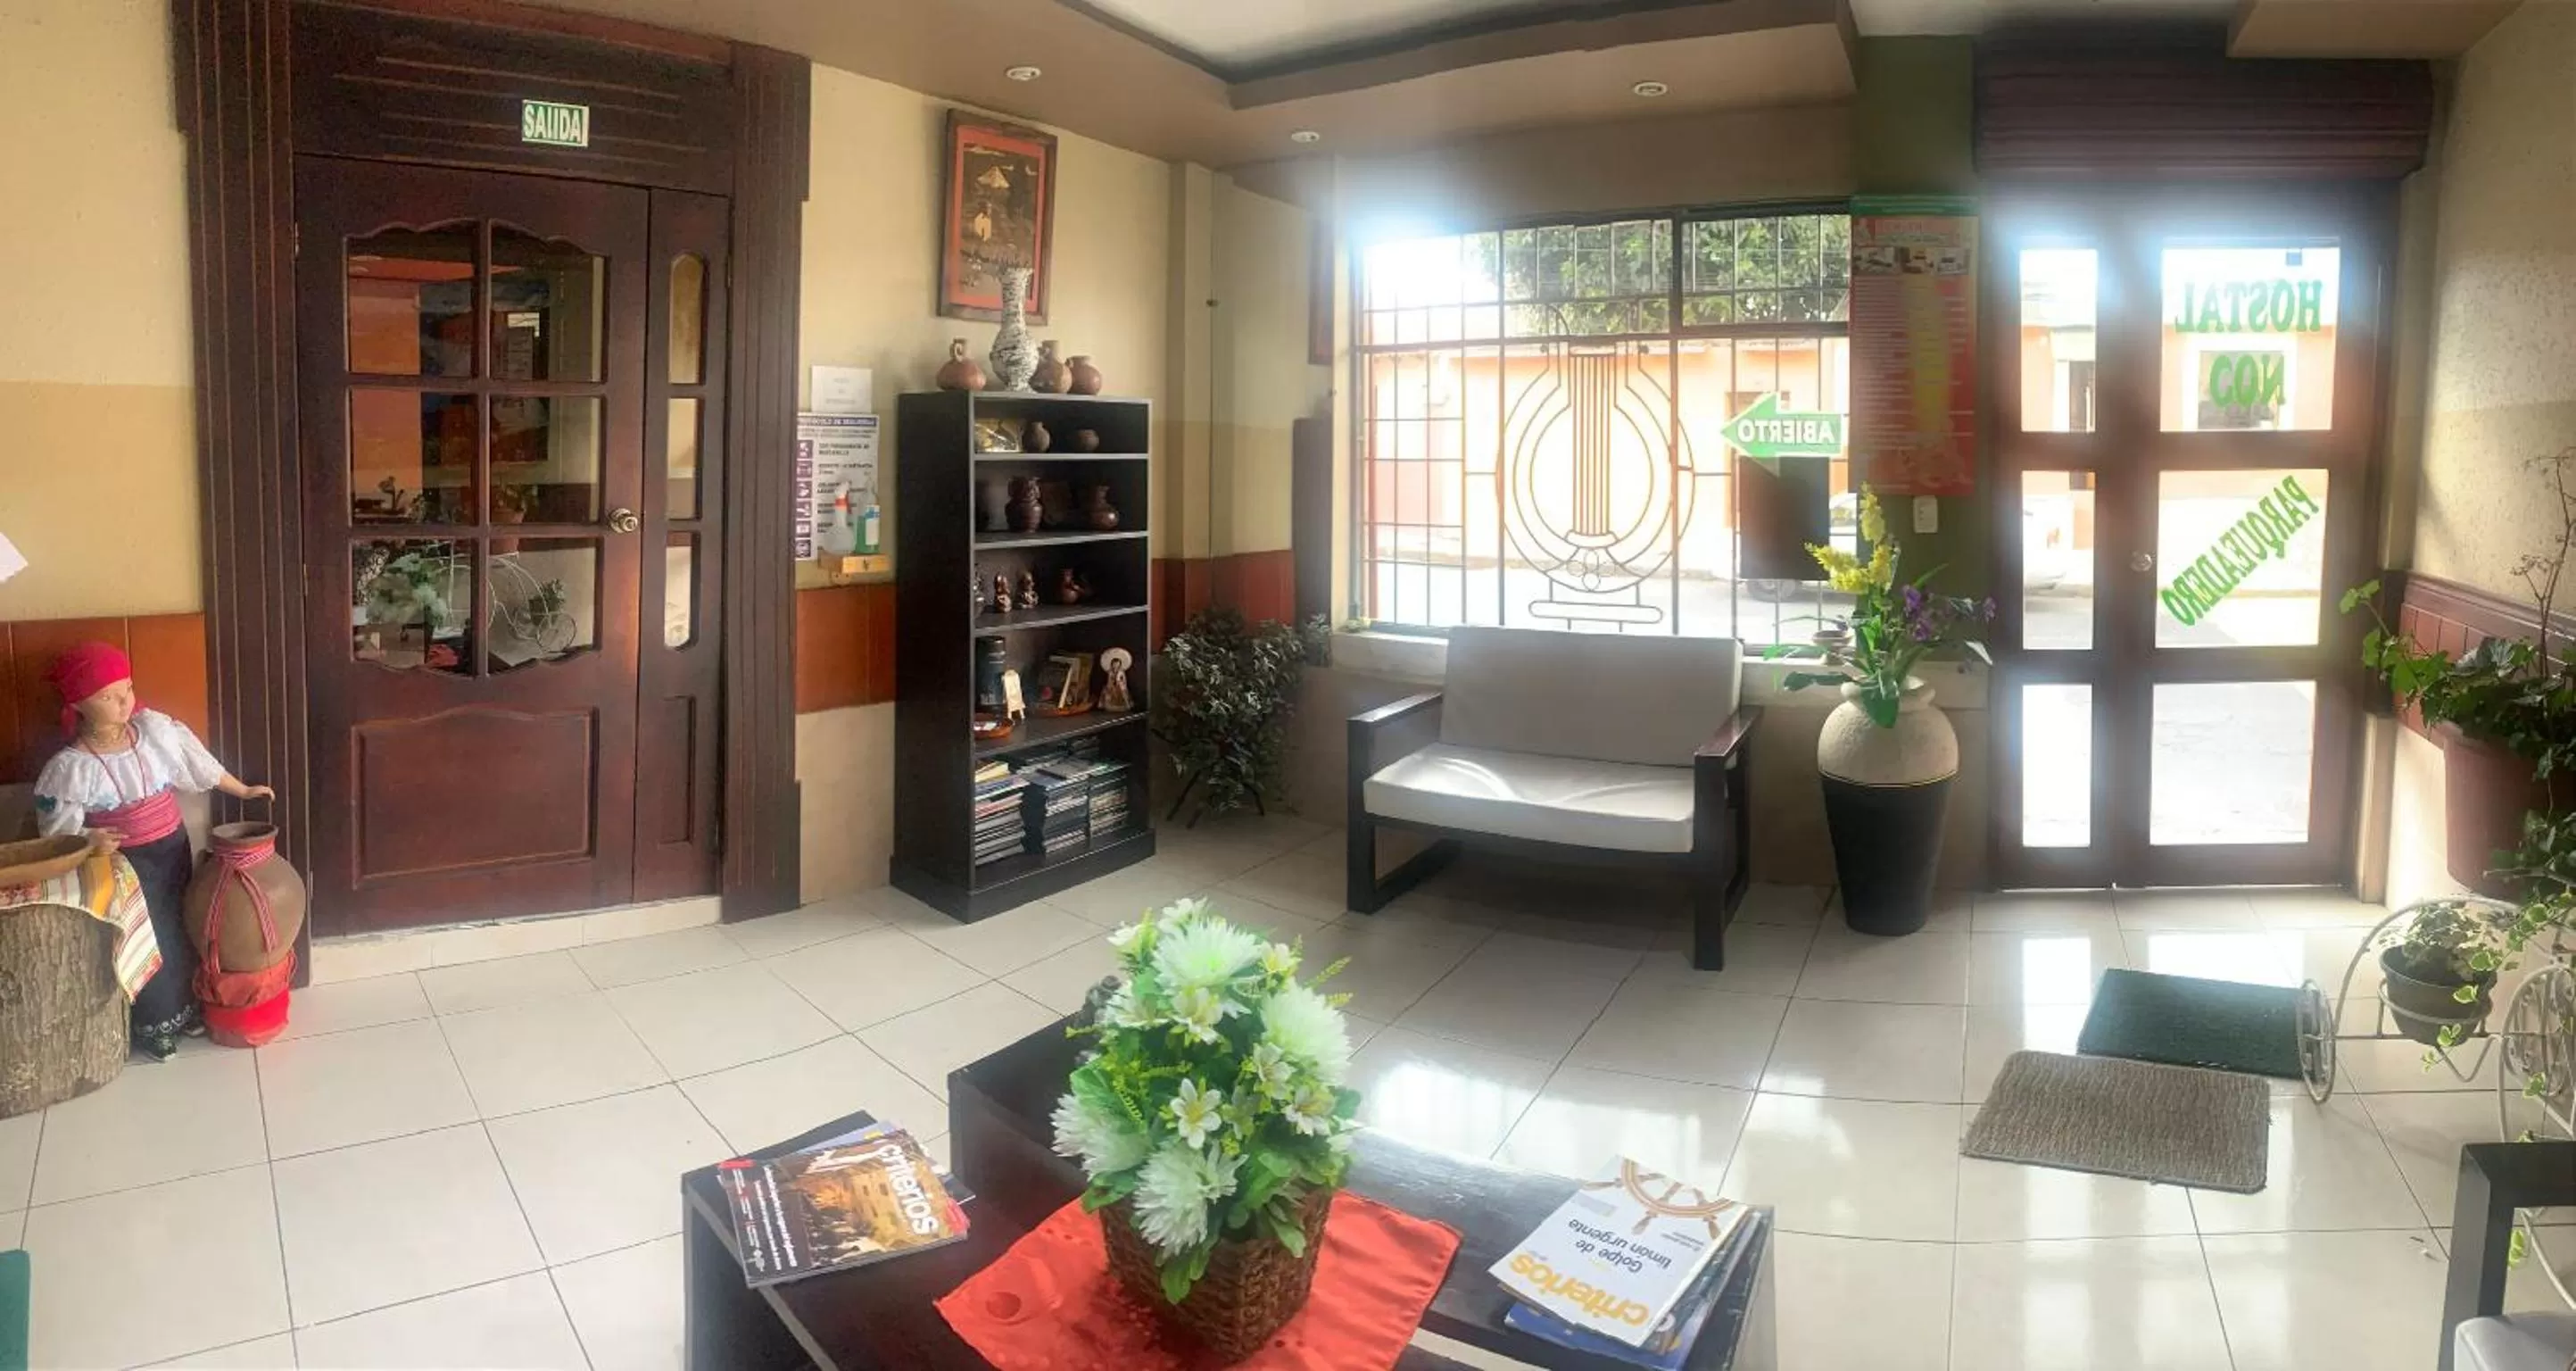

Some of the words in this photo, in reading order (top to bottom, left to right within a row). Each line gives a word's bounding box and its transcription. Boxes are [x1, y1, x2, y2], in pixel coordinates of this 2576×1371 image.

[524, 104, 582, 143] SALIDA
[1569, 1218, 1628, 1249] urgente
[1576, 1239, 1595, 1253] de
[1598, 1248, 1643, 1273] Golpe
[1509, 1253, 1650, 1327] criterios
